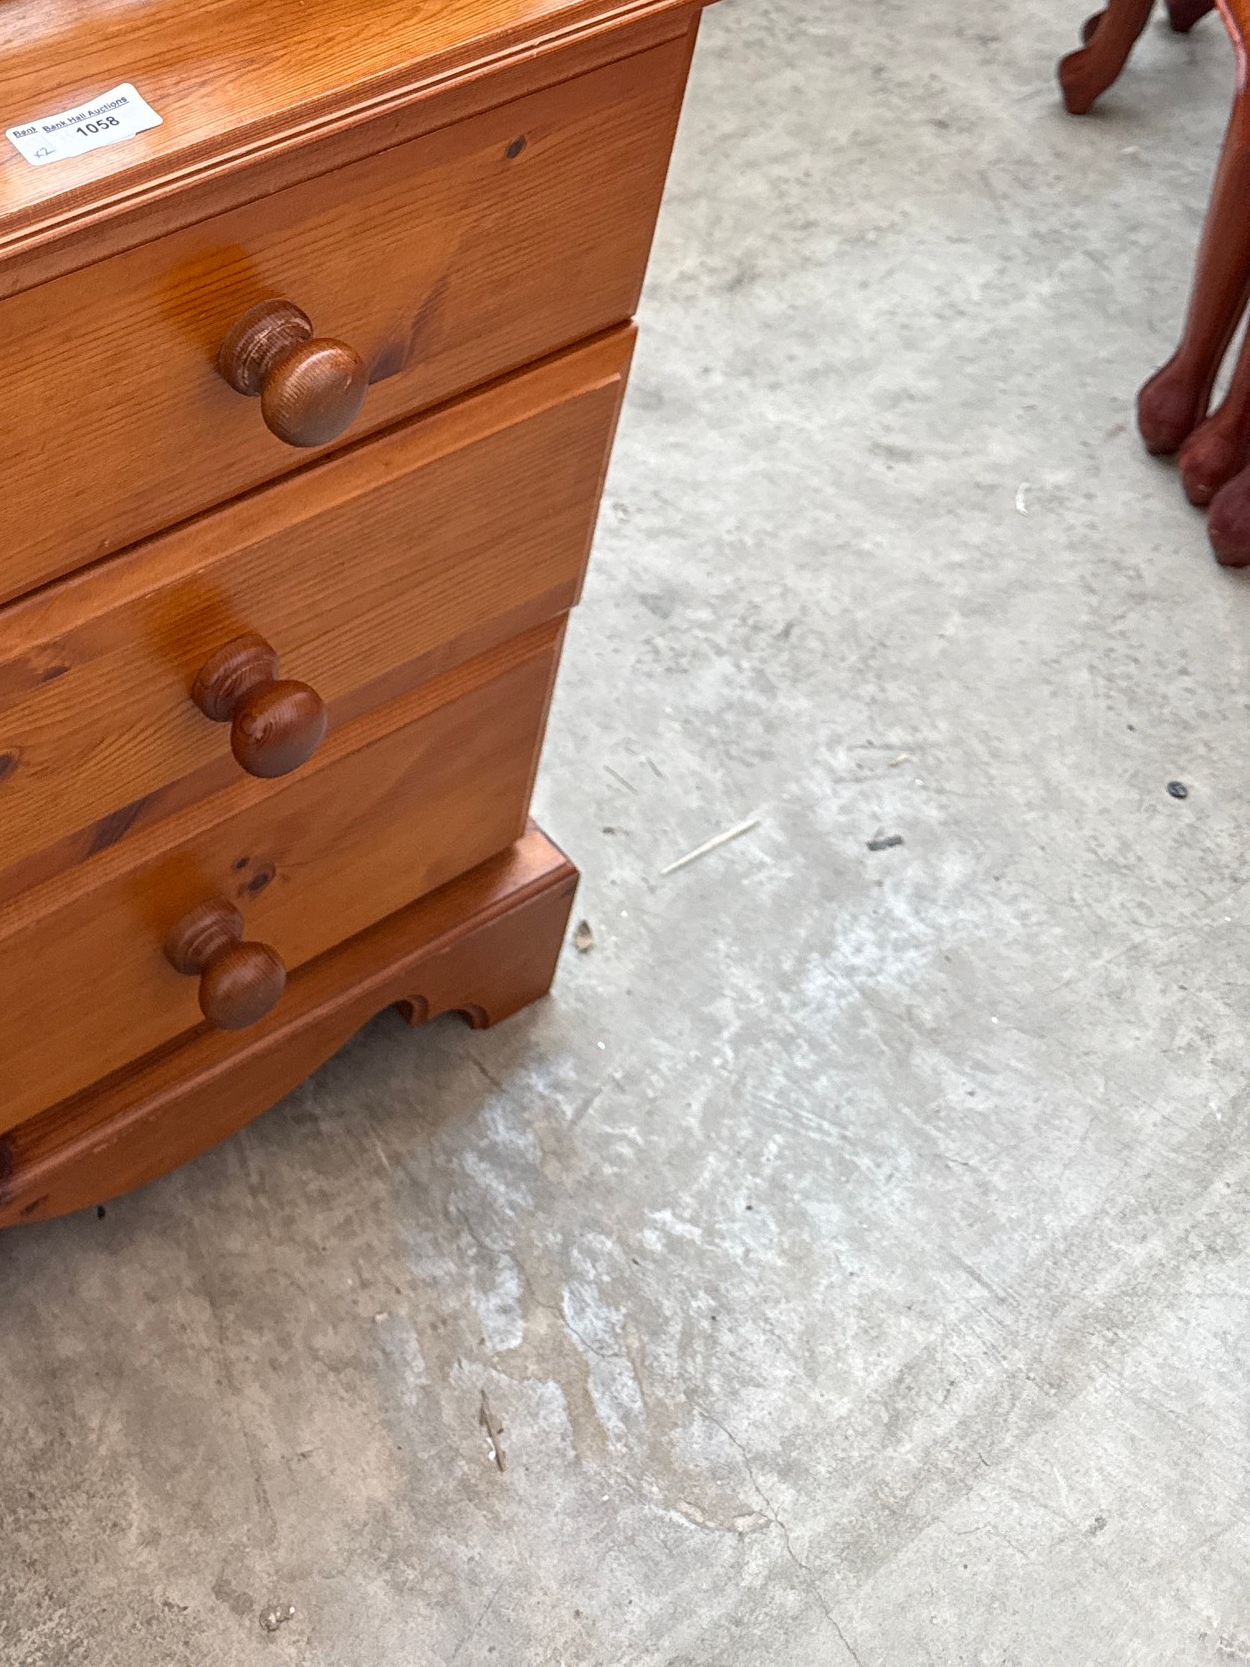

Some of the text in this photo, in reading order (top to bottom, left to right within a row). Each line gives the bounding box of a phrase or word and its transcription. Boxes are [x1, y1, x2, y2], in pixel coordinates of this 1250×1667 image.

[42, 95, 129, 134] Bank Hall Auctions
[76, 116, 120, 138] 1058
